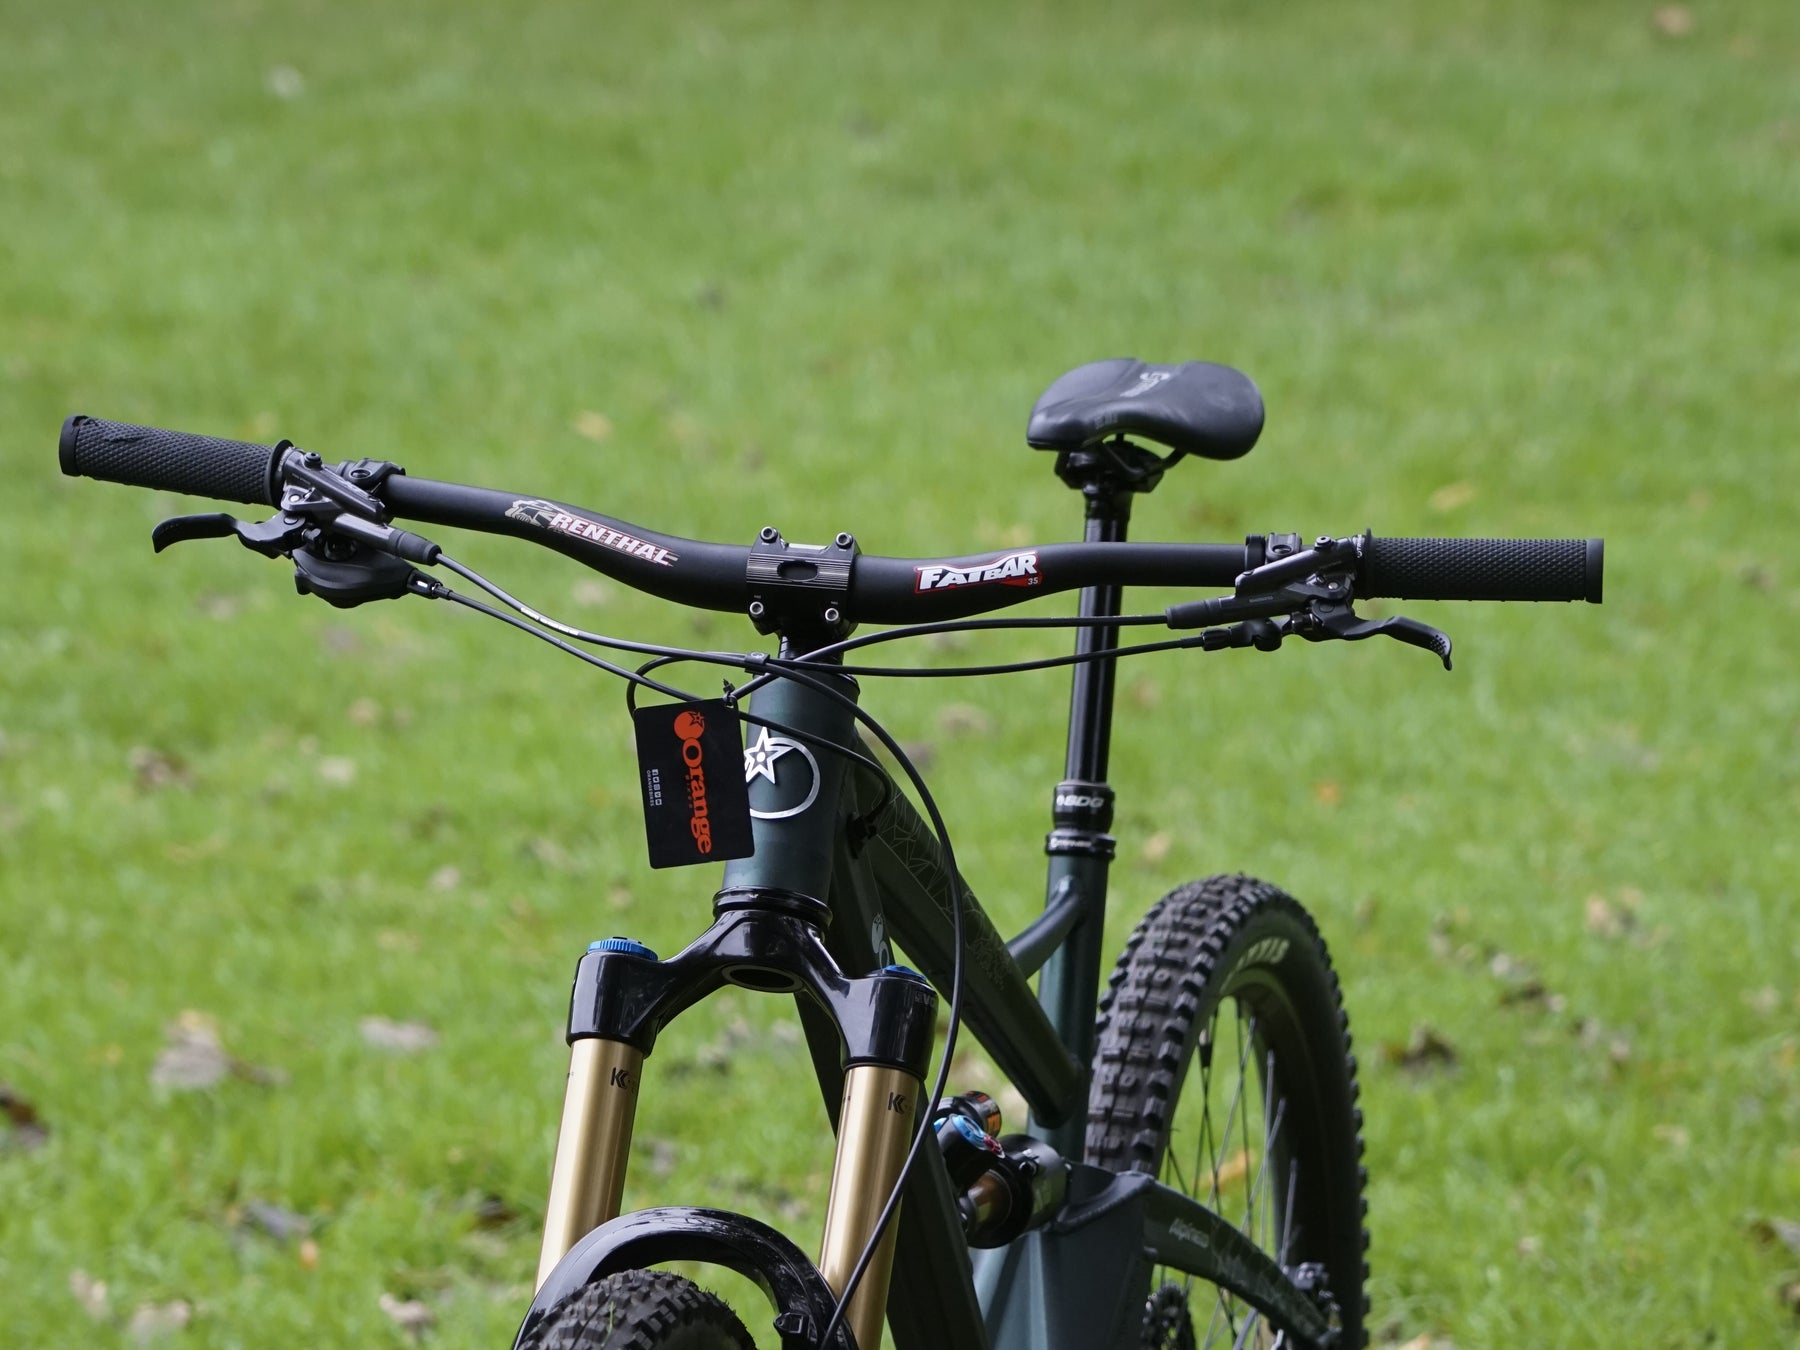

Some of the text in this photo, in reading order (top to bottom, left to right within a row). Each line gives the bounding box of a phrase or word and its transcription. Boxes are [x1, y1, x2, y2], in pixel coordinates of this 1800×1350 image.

[550, 513, 673, 567] RENTHAL
[919, 554, 1038, 590] FATBAR
[1027, 577, 1039, 586] 35
[682, 737, 712, 854] Orange
